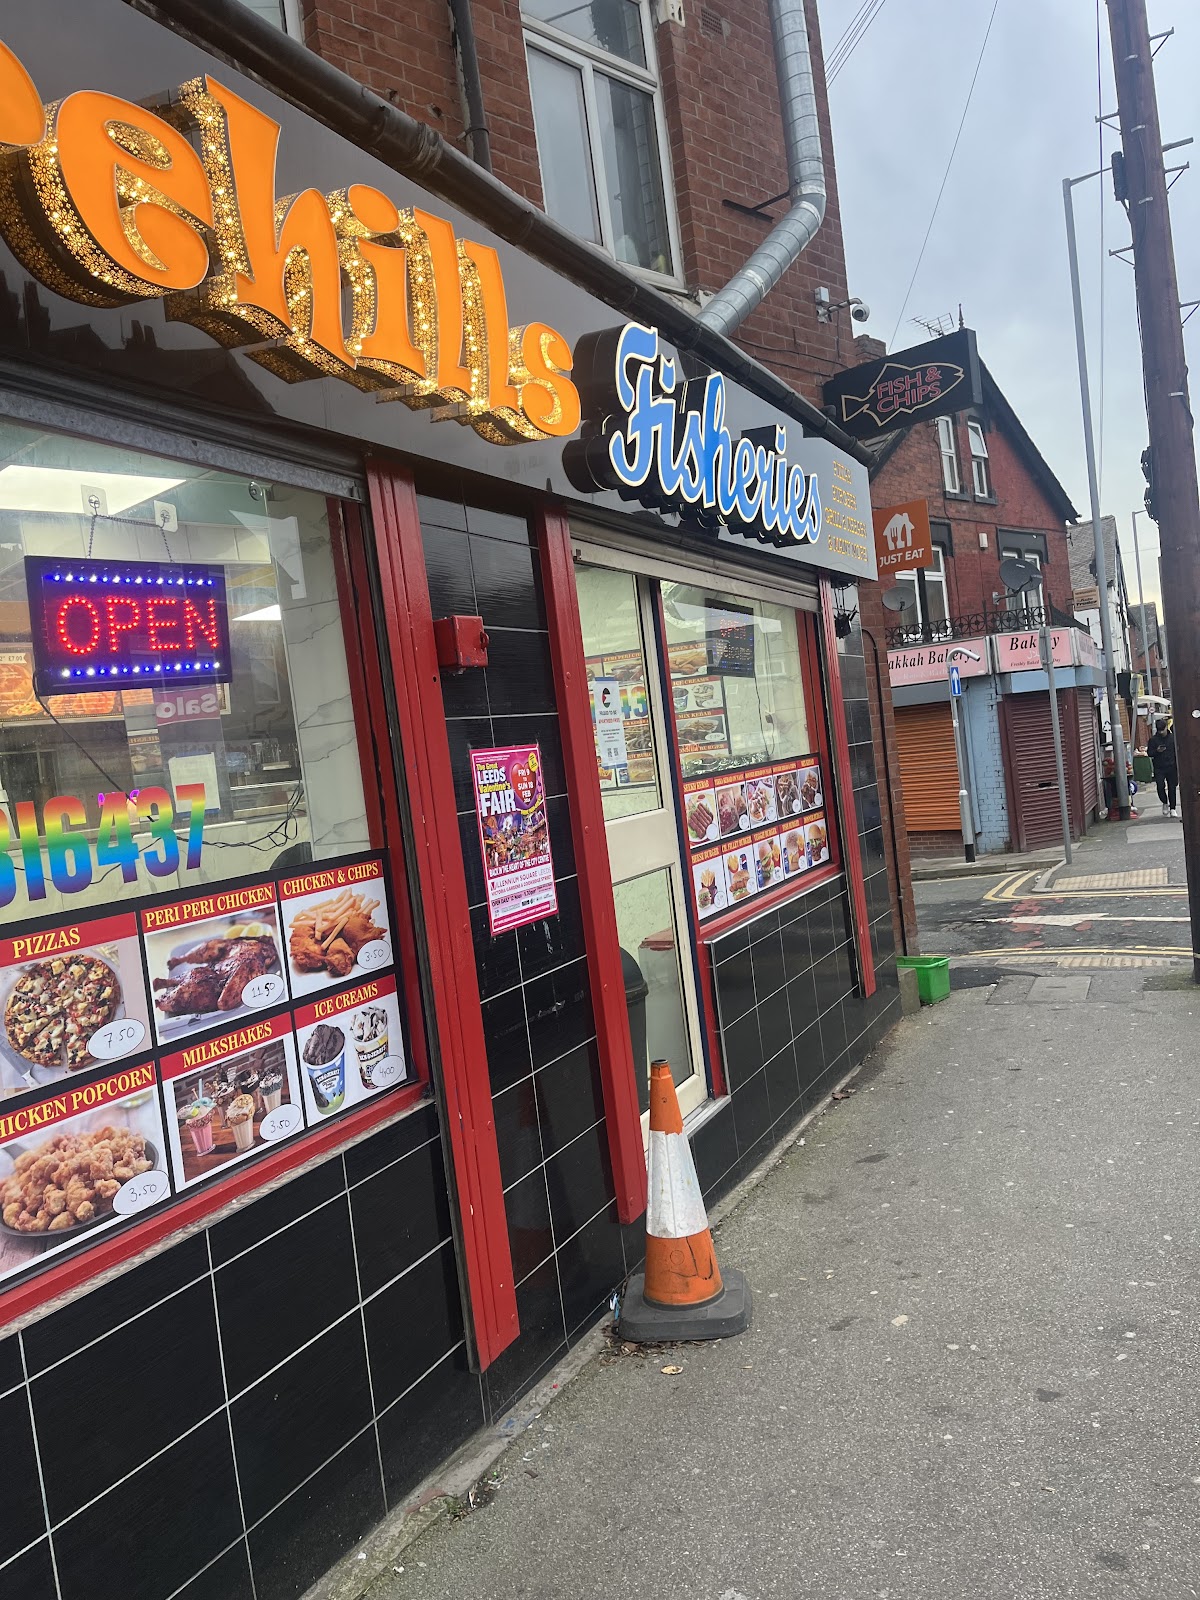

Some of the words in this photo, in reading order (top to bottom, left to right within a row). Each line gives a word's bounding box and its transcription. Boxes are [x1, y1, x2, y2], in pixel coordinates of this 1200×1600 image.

[877, 371, 922, 399] FISH
[925, 366, 942, 383] &
[876, 382, 941, 413] CHIPS
[609, 322, 822, 544] Fisheries
[880, 552, 903, 568] JUST
[905, 548, 924, 560] EAT
[57, 595, 219, 654] OPEN
[1009, 635, 1060, 651] Baky
[888, 653, 924, 670] akkah
[477, 766, 506, 785] LEEDS
[518, 769, 526, 777] FRI
[479, 781, 511, 794] Valentine's
[518, 782, 528, 790] SUN
[522, 790, 531, 798] FEB
[480, 789, 516, 818] FAIR
[283, 872, 335, 896] CHICKEN
[337, 869, 346, 884] &
[347, 862, 379, 881] CHIPS
[145, 911, 180, 928] PERI
[183, 900, 215, 920] PERI
[216, 885, 273, 911] CHICKEN
[12, 927, 81, 959] PIZZAS
[365, 949, 384, 962] 3.50
[314, 998, 334, 1019] ICE
[335, 983, 379, 1009] CREAMS
[104, 1026, 136, 1049] 7.50
[182, 1021, 273, 1069] MILKSHAKES
[71, 1065, 153, 1111] POPCORN
[270, 1119, 291, 1134] 3.50
[129, 1184, 157, 1203] 3.50
